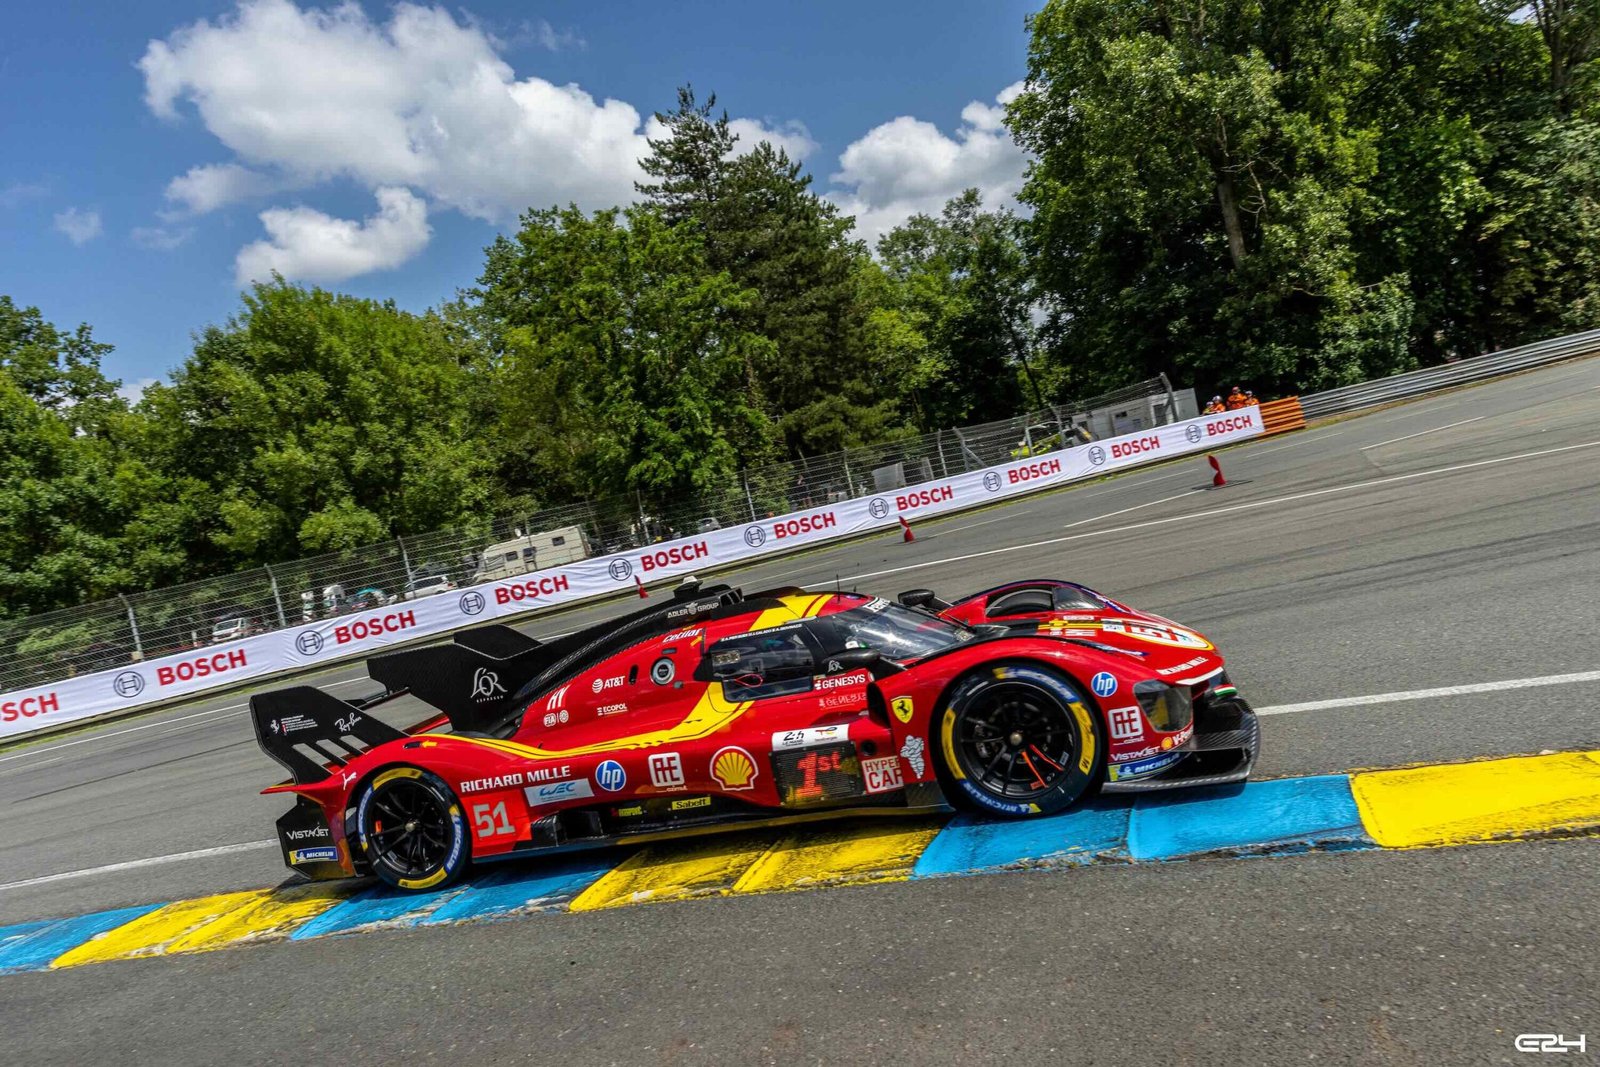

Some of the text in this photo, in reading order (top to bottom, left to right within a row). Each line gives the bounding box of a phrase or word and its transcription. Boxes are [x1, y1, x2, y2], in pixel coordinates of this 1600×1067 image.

[1207, 416, 1253, 436] BOSCH
[1111, 436, 1160, 459] BOSCH
[1007, 459, 1061, 484] BOSCH
[895, 486, 953, 512] BOSCH
[774, 513, 836, 539] BOSCH
[640, 542, 708, 572] BOSCH
[495, 575, 569, 605] BOSCH
[667, 602, 719, 618] ADLER GROUP
[334, 610, 416, 645] BOSCH
[156, 649, 247, 686] BOSCH
[603, 675, 626, 690] AT&T
[822, 674, 866, 689] GENESYS
[1096, 674, 1113, 696] hp
[1, 692, 60, 722] SCH
[603, 702, 628, 713] ECOPOL
[796, 751, 841, 799] 1st
[1134, 753, 1180, 773] MICHELIN
[460, 765, 571, 793] RICHARD MILLE
[540, 782, 577, 796] WEC
[603, 763, 622, 790] hp
[473, 800, 516, 838] 51
